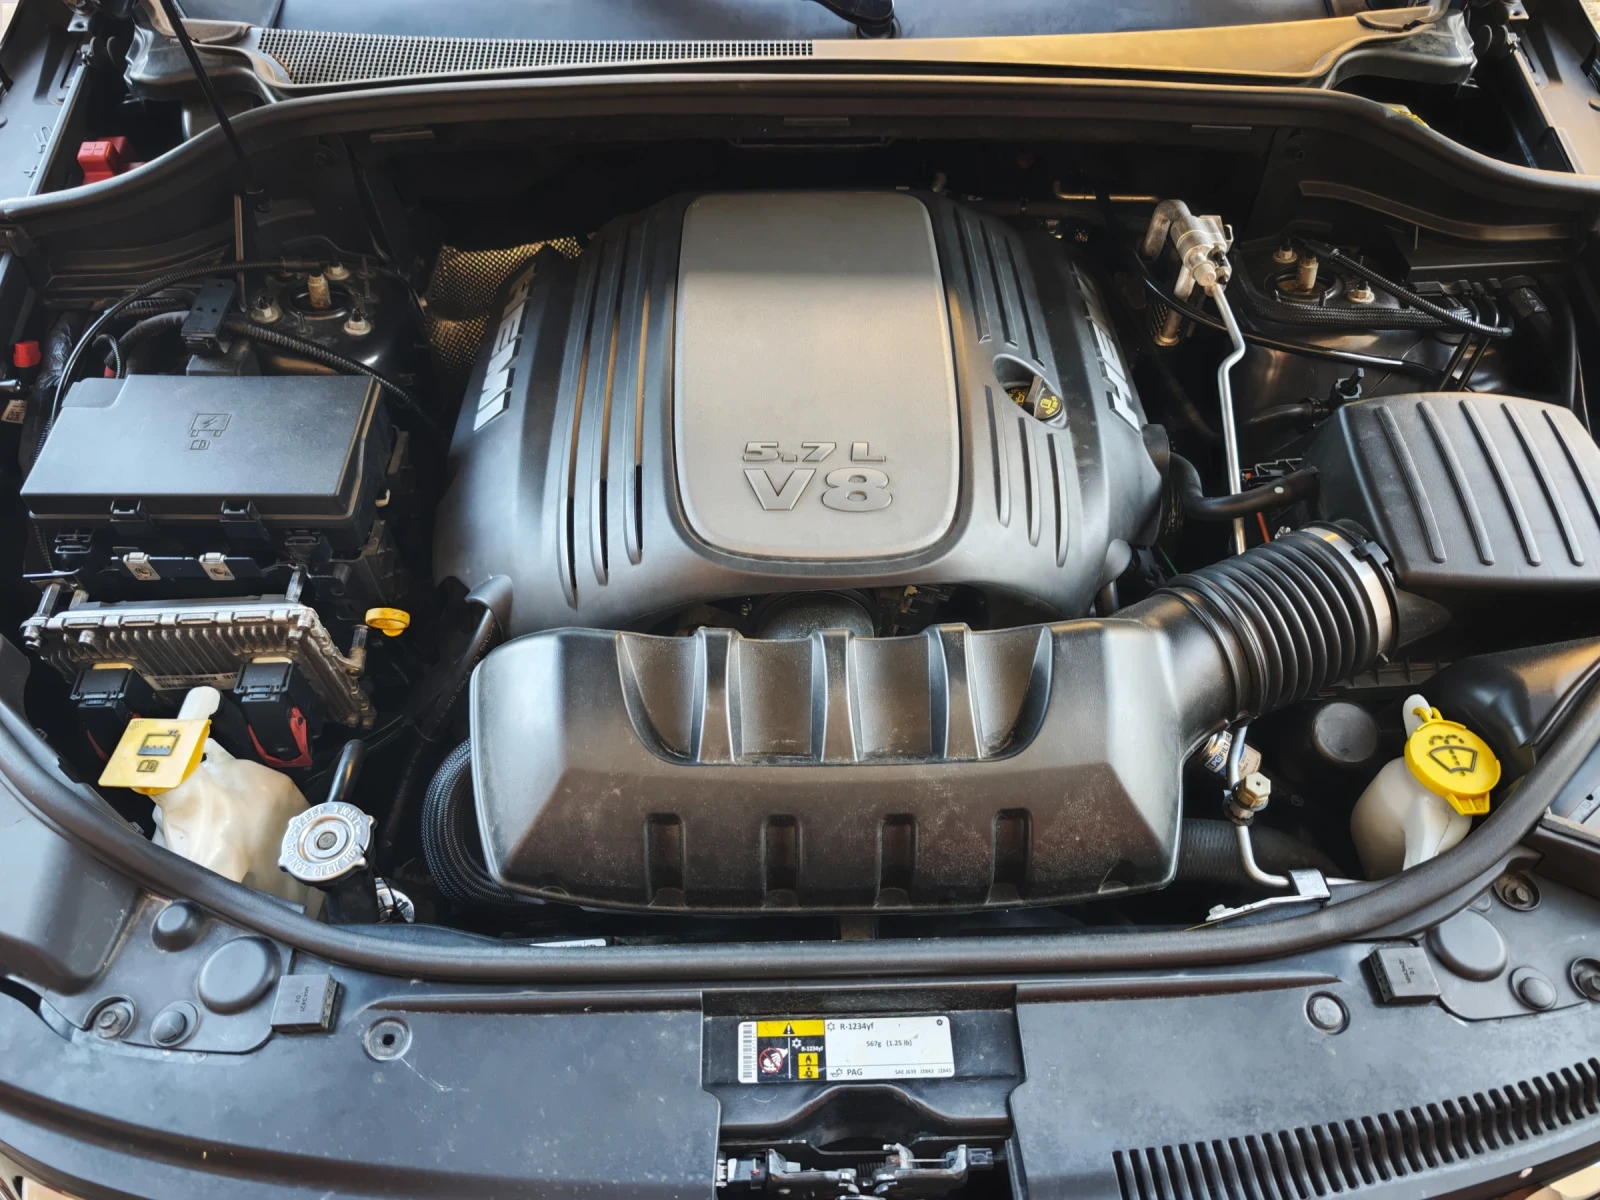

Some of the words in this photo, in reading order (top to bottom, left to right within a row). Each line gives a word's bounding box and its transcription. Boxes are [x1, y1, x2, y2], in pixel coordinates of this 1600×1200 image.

[743, 441, 837, 463] 5.7
[850, 441, 887, 463] L
[743, 467, 893, 513] V8
[1207, 754, 1223, 770] LPG
[296, 806, 326, 827] KEEP
[290, 857, 307, 874] NOT
[839, 1022, 874, 1031] R-1234yf
[846, 1068, 863, 1076] PAG
